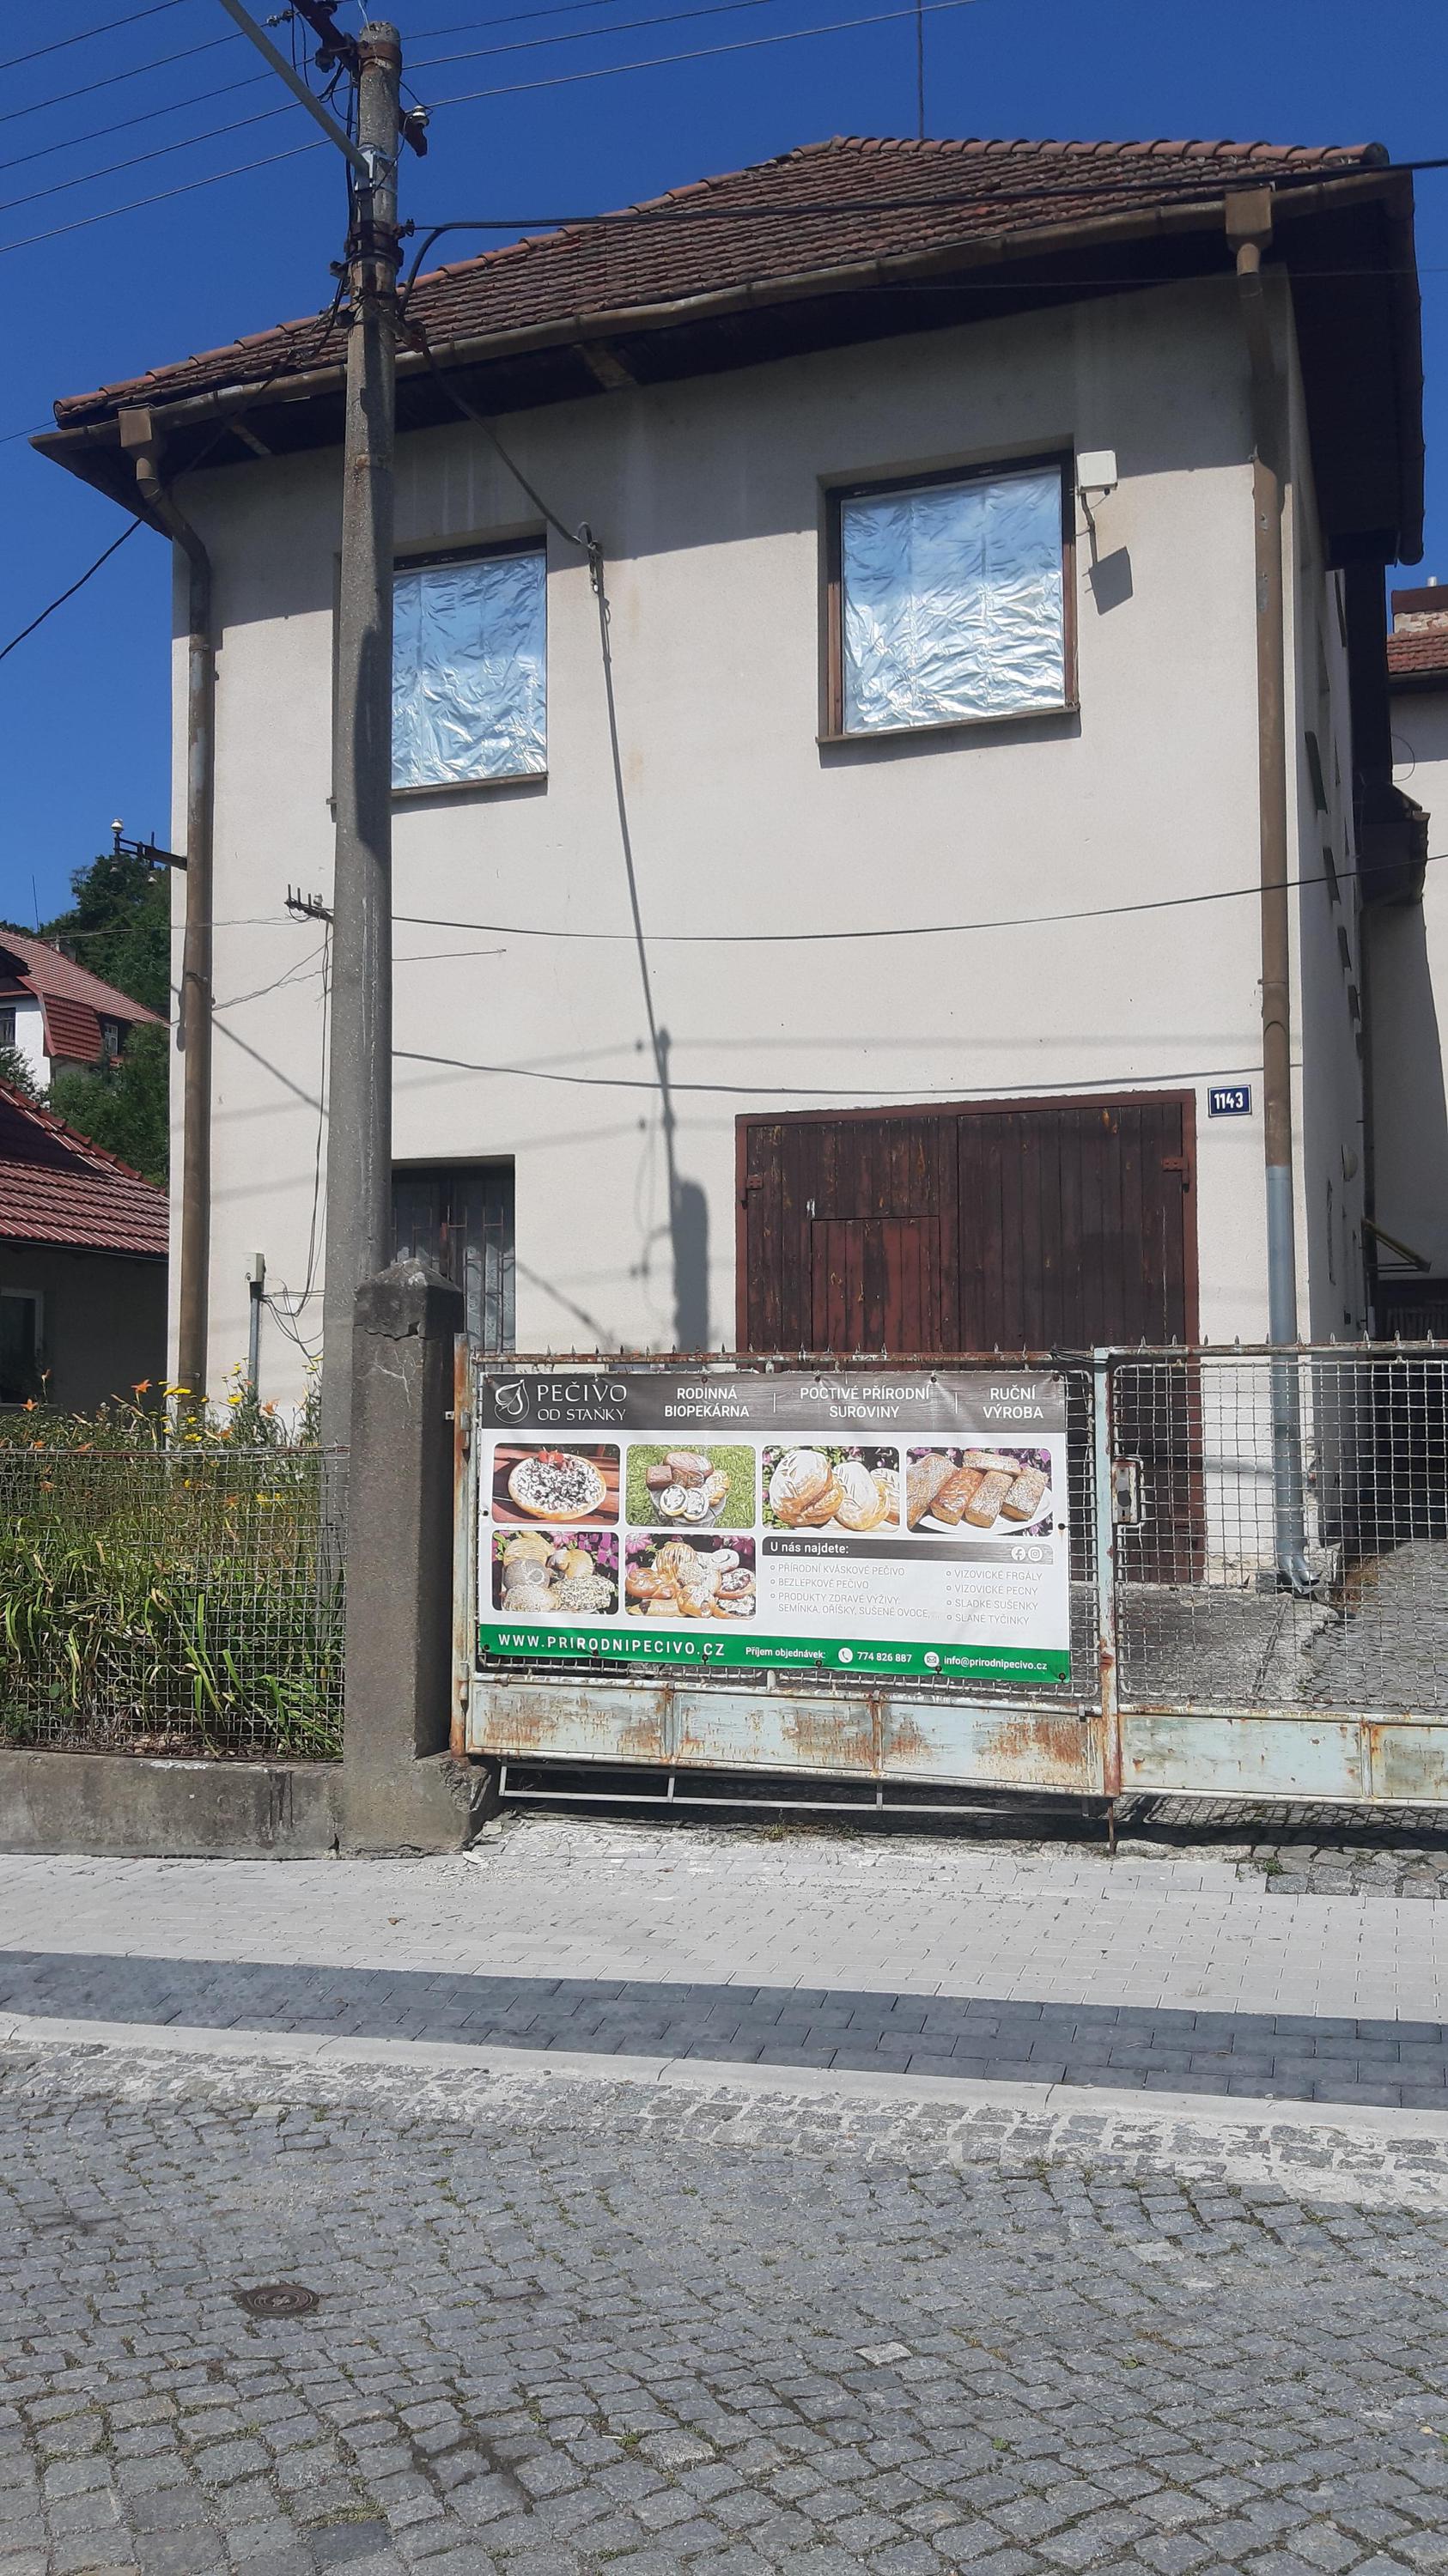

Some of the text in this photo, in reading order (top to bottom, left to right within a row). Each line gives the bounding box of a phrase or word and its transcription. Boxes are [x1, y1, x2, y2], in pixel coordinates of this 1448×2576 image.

[1214, 1091, 1244, 1110] 1143
[537, 1381, 627, 1402] PEČIVO
[677, 1386, 738, 1400] RODINNÁ
[800, 1384, 930, 1400] POCTIVÉ PŘÍRODNÍ
[990, 1385, 1036, 1400] RUČNÍ
[537, 1406, 626, 1421] OD STAŇKY
[665, 1404, 750, 1419] BIOPEKÁRNA
[829, 1406, 900, 1419] SUROVINY
[983, 1405, 1043, 1419] VÝROBA
[770, 1541, 849, 1556] U nás najdete:
[778, 1563, 821, 1574] PŘÍRODNÍ
[872, 1565, 905, 1577] PEČIVO
[954, 1569, 1043, 1582] VIZOVICKÉ FRGÁLY
[836, 1578, 869, 1589] PEČIVO
[778, 1592, 826, 1601] PRODUKTY
[994, 1599, 1038, 1611] SUŠENKY
[988, 1614, 1030, 1625] TYČINKY
[497, 1633, 725, 1656] WWW.PRIRODNIPECIVO.CZ
[745, 1647, 773, 1657] Příjem
[857, 1652, 912, 1663] 774 826 887
[944, 1656, 1048, 1671] info@prirodnipecivo.cz
